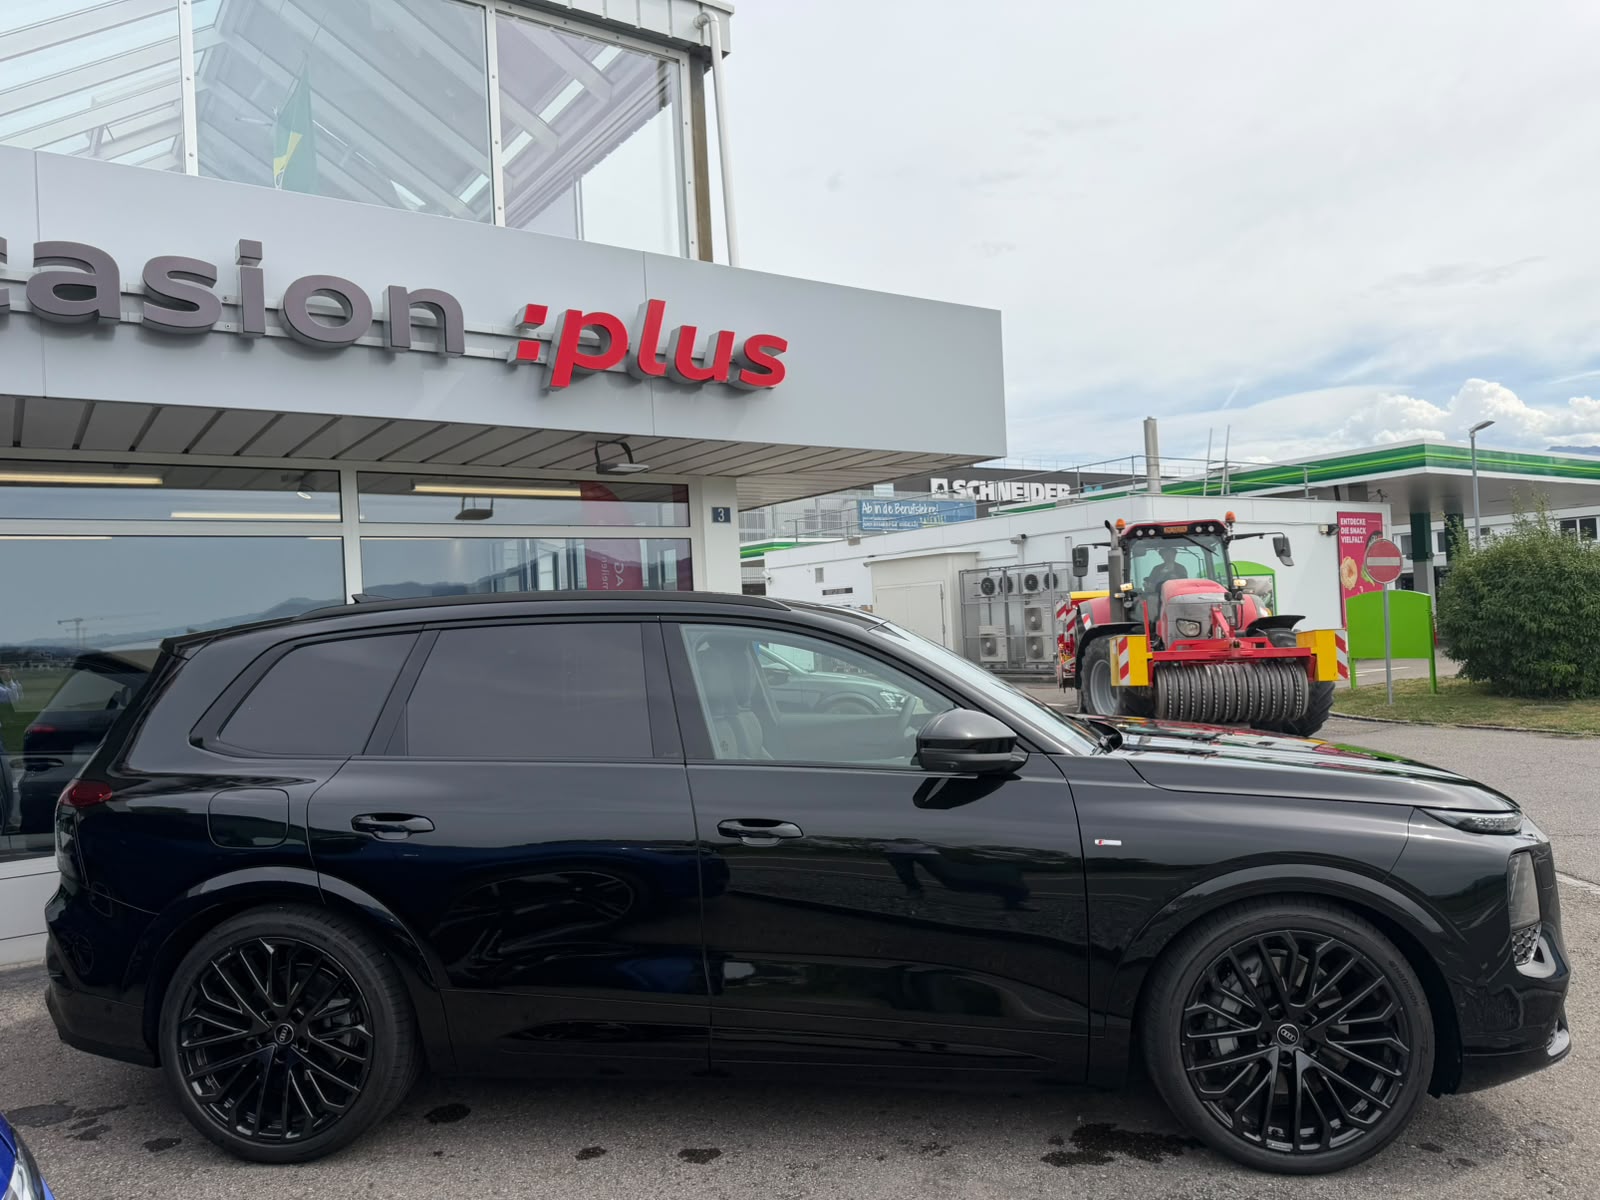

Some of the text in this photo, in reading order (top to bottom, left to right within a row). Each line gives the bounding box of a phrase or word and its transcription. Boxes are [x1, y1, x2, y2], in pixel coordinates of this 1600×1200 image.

[0, 238, 466, 357] asion
[952, 479, 1071, 502] SCHNEIDER
[862, 502, 872, 514] Ab
[718, 508, 724, 521] 3
[1340, 517, 1366, 526] ENTDECKE
[1341, 526, 1366, 535] DIE SNACK
